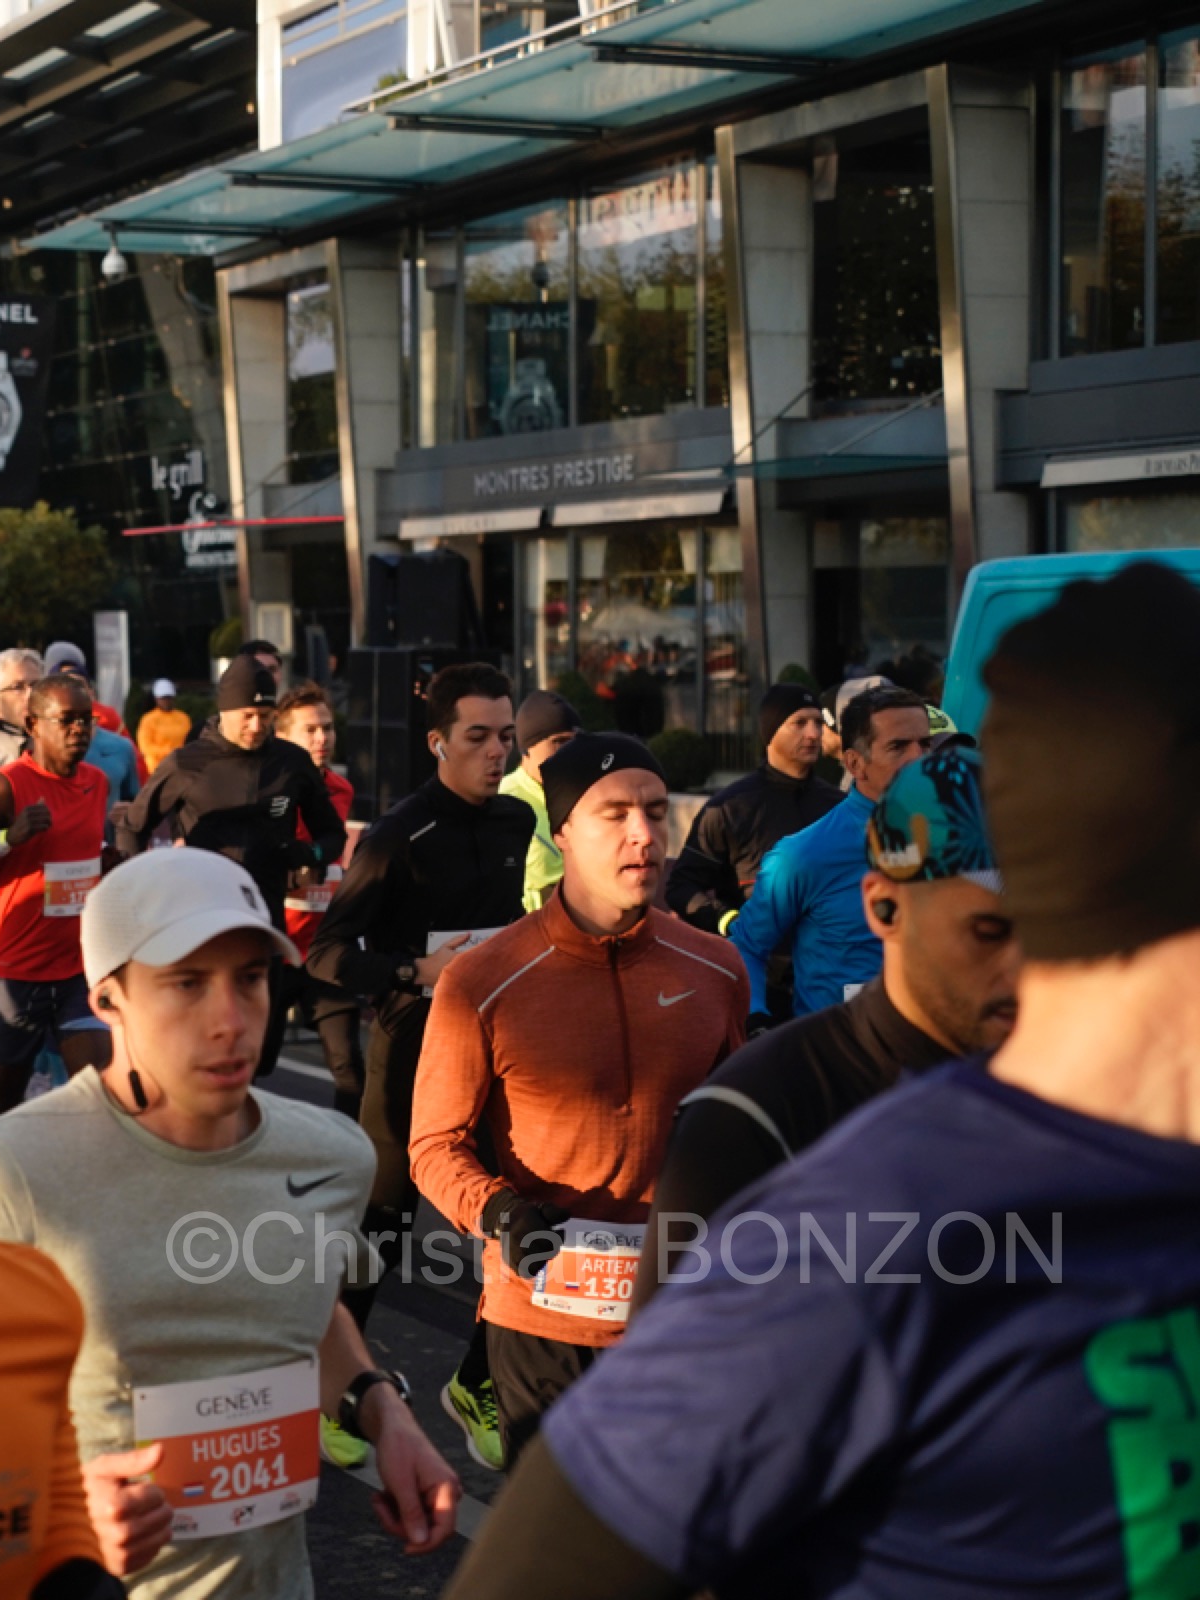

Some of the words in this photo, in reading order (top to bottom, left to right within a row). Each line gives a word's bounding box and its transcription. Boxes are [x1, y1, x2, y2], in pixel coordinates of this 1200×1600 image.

[472, 463, 549, 496] MONTRES
[552, 452, 635, 488] PRESTIGE
[581, 1257, 639, 1275] ARTEM
[191, 1424, 282, 1463] HUGUES
[209, 1452, 289, 1500] 2041
